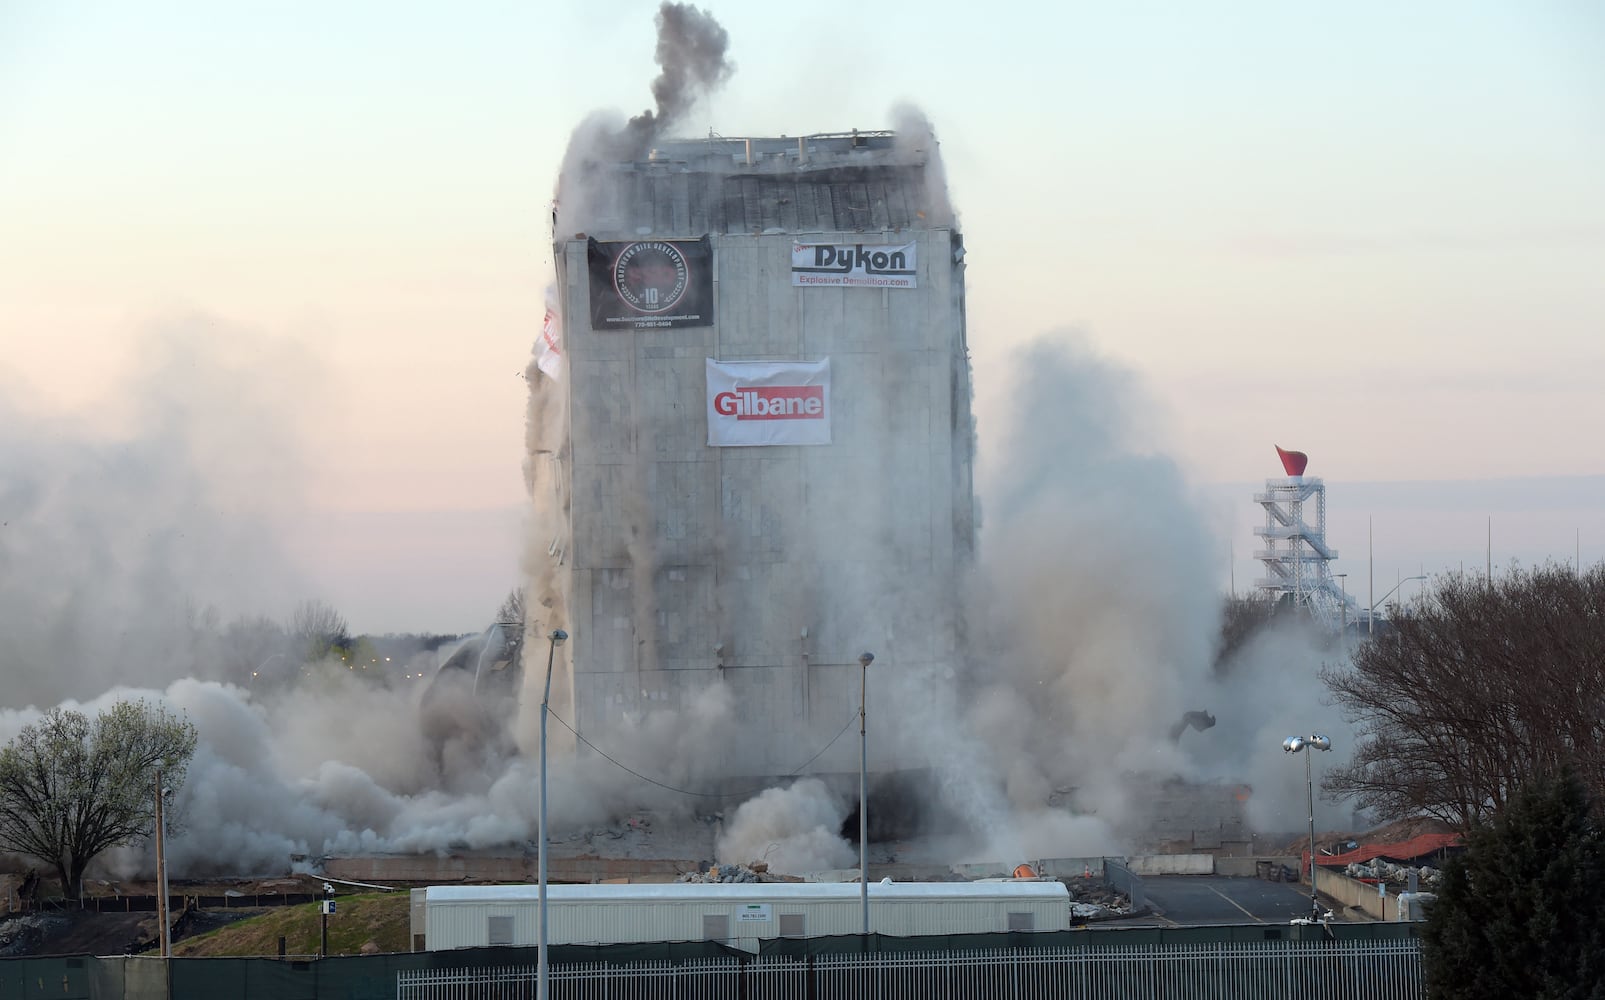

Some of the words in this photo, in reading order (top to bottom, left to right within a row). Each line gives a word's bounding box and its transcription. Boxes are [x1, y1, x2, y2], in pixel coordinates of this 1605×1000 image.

[618, 249, 635, 282] SOUTHERN
[636, 243, 650, 252] SITE
[654, 243, 684, 280] DEVELOPMENT
[815, 244, 906, 274] Dykon
[799, 275, 841, 285] Explosive
[843, 276, 909, 286] Demolition.com
[714, 391, 822, 417] Gilbane
